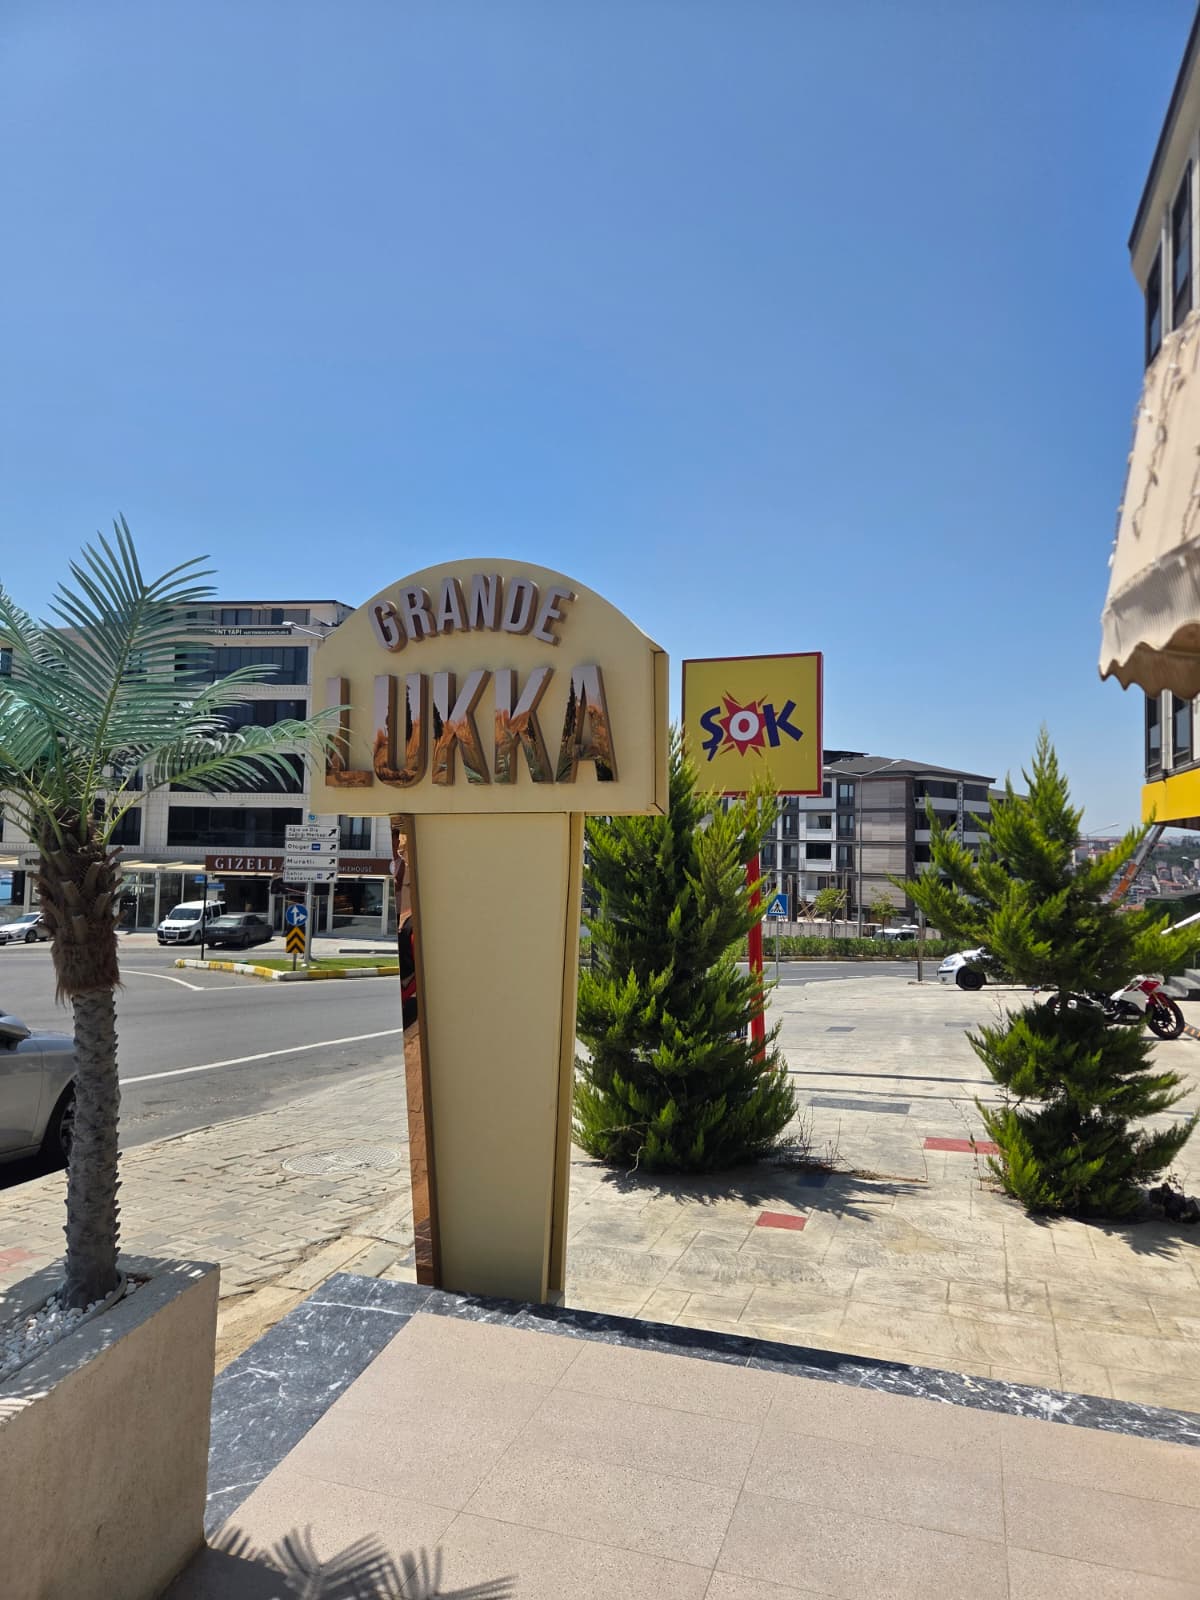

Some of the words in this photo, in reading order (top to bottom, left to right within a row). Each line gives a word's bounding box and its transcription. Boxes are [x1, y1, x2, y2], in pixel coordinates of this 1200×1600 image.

[368, 574, 577, 652] GRANDE
[325, 665, 618, 787] LUKKA
[700, 699, 804, 762] ŞOK
